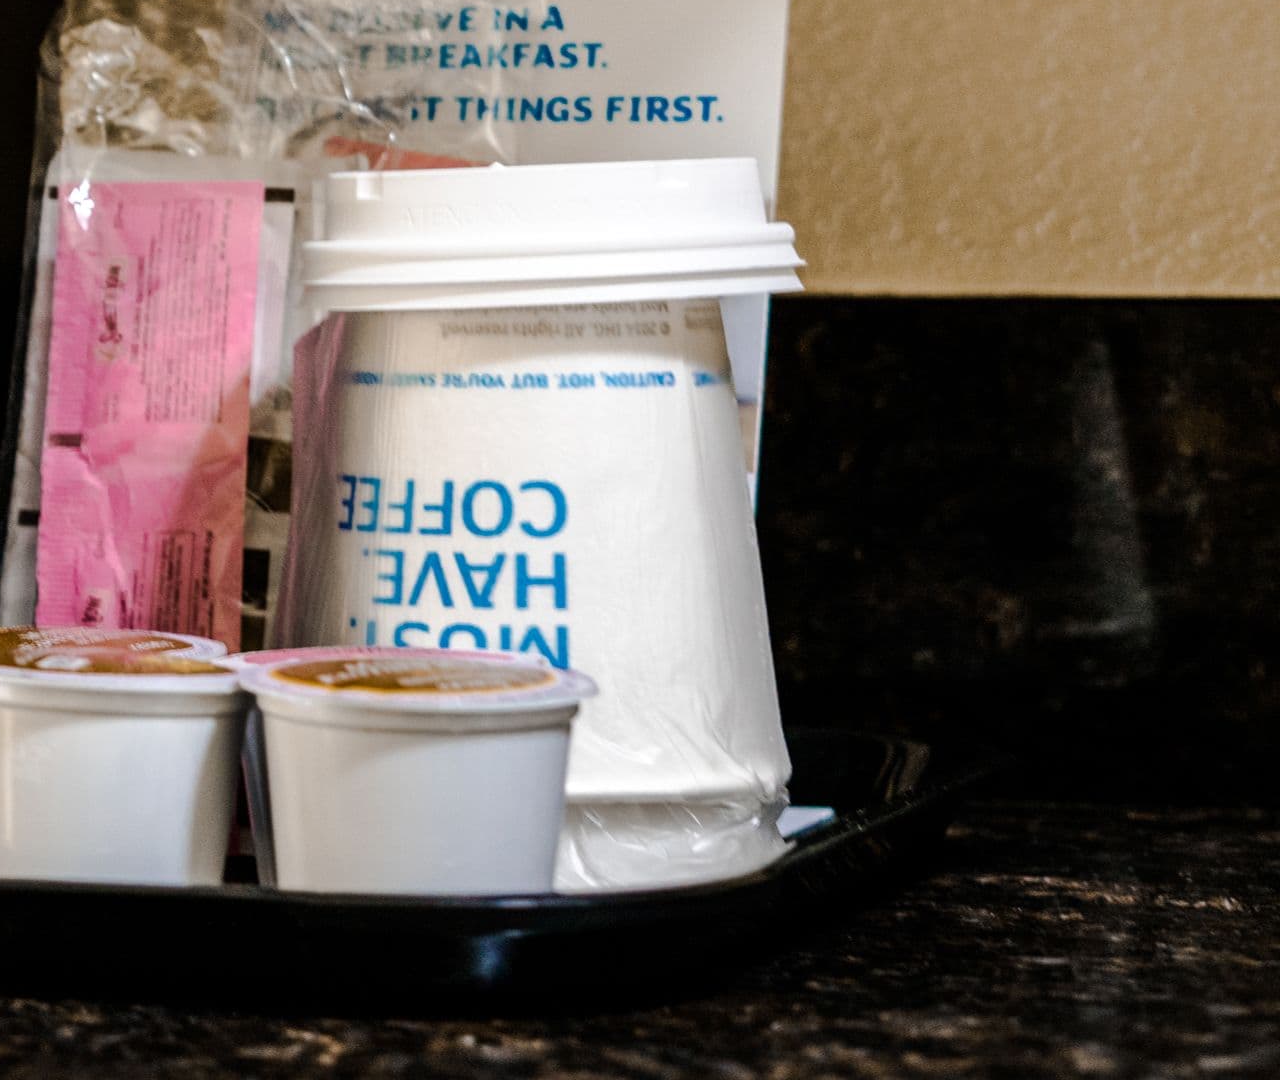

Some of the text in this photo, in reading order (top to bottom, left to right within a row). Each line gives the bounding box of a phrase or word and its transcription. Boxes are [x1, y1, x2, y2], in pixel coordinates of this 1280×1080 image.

[494, 6, 529, 32] IN
[542, 6, 565, 32] A
[386, 42, 608, 69] BREAKFAST.
[458, 96, 592, 122] THINGS
[606, 95, 724, 122] FIRST.
[513, 320, 560, 337] rights
[442, 373, 505, 389] YOU'RE
[511, 373, 548, 389] BUT
[600, 372, 675, 389] CAUTION,
[338, 474, 568, 538] COFFEE
[362, 547, 568, 609] HAVE.
